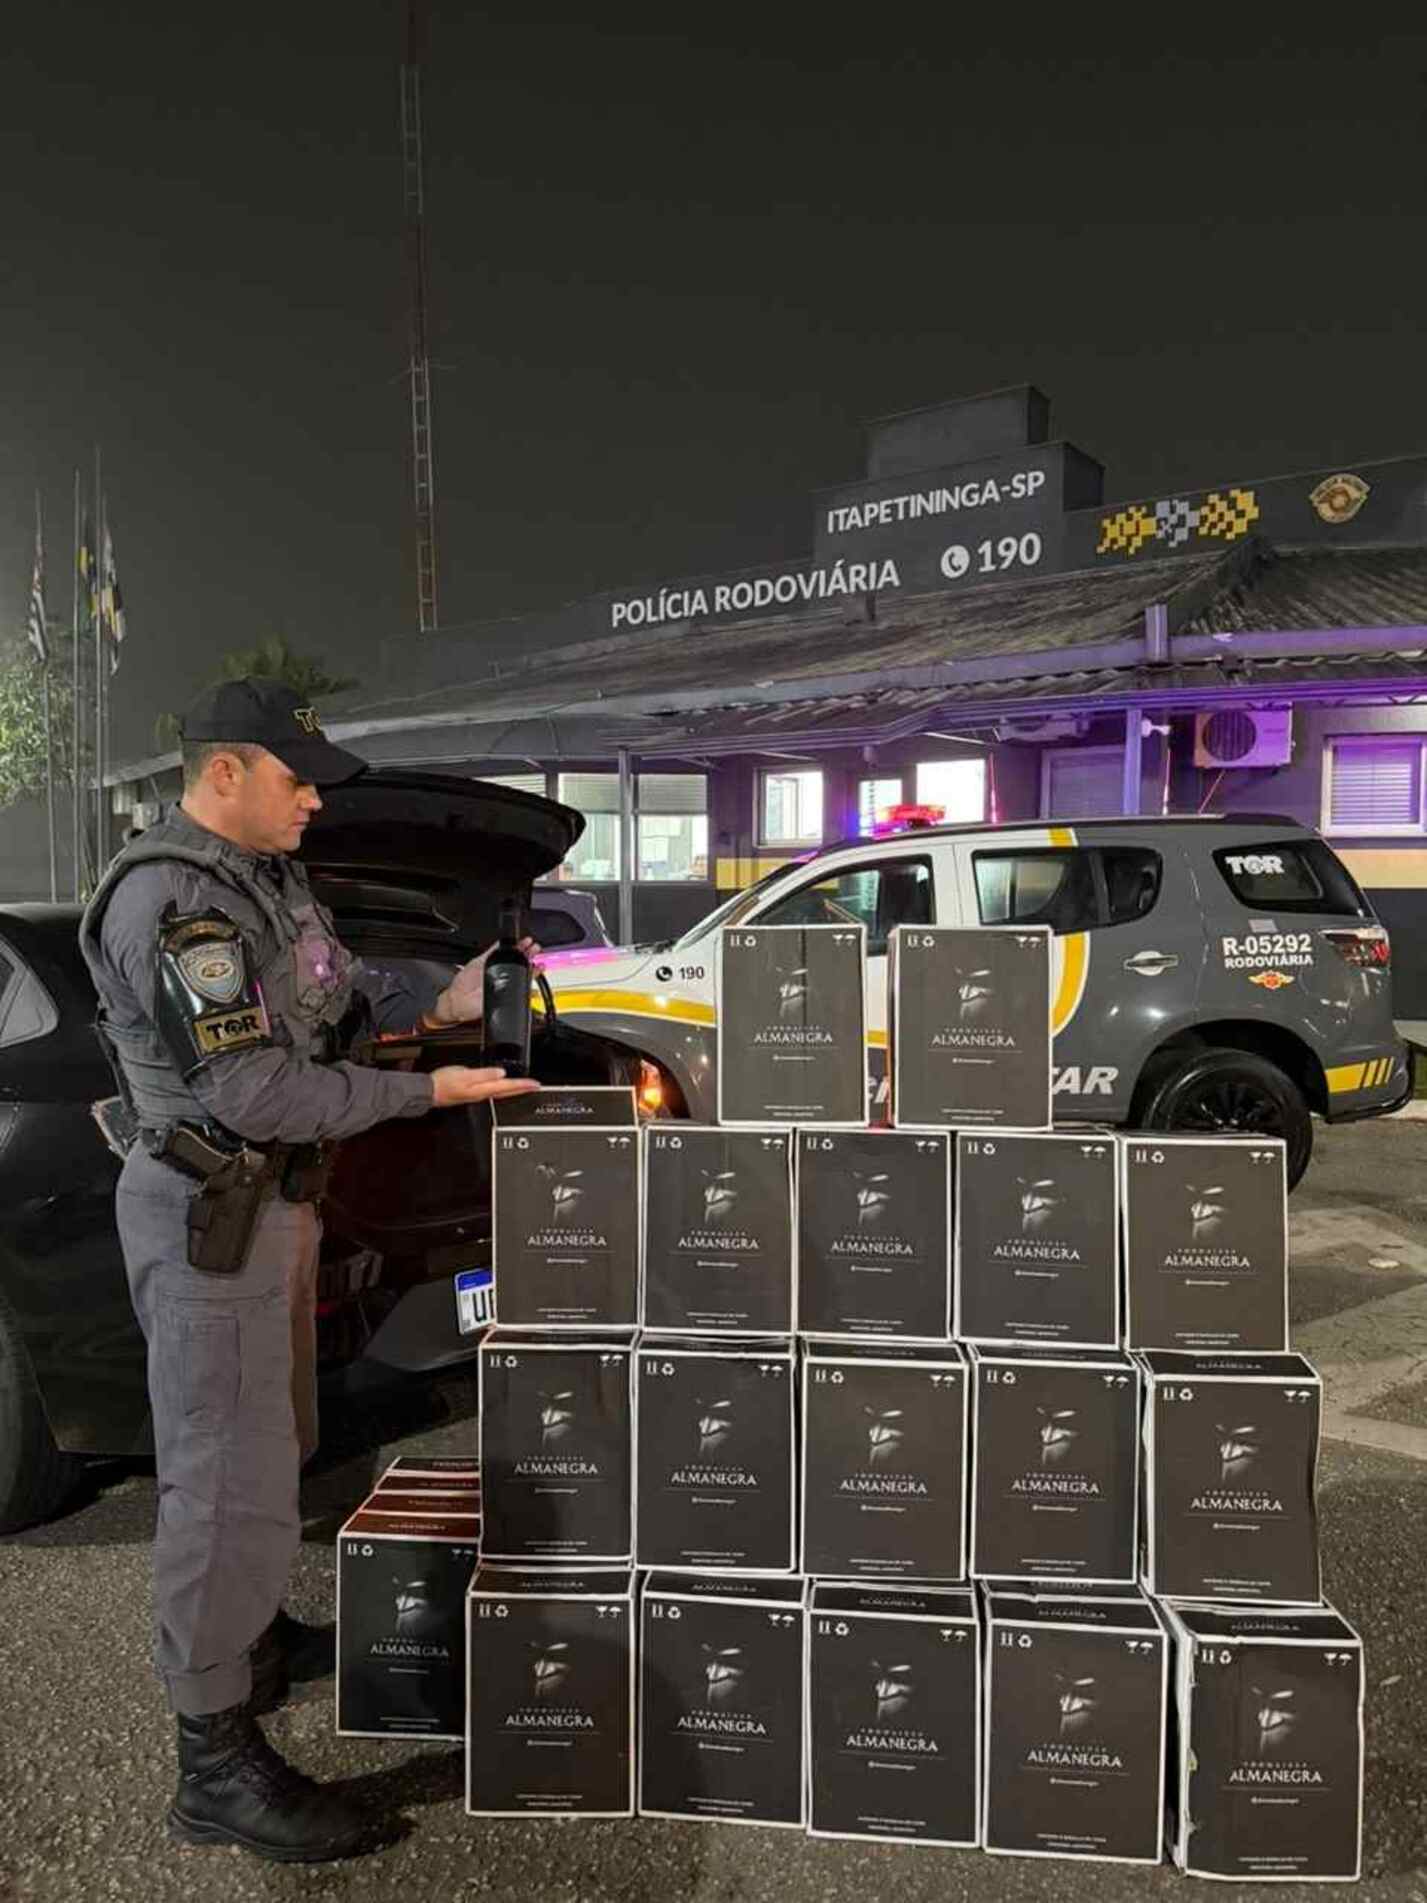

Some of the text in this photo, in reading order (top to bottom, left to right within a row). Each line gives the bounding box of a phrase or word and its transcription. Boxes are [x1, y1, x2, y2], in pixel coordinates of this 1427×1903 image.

[827, 471, 1045, 533] ITAPETININGA-SP
[977, 532, 1042, 573] 190
[612, 559, 900, 628] POLÍCIA RODOVIÁRIA
[1224, 854, 1285, 875] TOR
[1222, 934, 1312, 956] R-05292
[1224, 953, 1313, 969] RODOVIÁRIA
[680, 966, 705, 980] 190
[206, 1015, 260, 1041] TOR
[753, 1032, 833, 1043] ALMANEGRA
[931, 1034, 1015, 1047] ALMANEGRA
[527, 1234, 607, 1247] ALMANEGRA
[678, 1236, 759, 1250] ALMANEGRA
[831, 1241, 913, 1255] ALMANEGRA
[993, 1245, 1081, 1260] ALMANEGRA
[1164, 1255, 1251, 1268] ALMANEGRA
[514, 1462, 599, 1475] ALMANEGRA
[671, 1471, 757, 1486] ALMANEGRA
[839, 1479, 928, 1494] ALMANEGRA
[1011, 1479, 1100, 1494] ALMANEGRA
[1191, 1497, 1283, 1511] ALMANEGRA
[370, 1643, 449, 1657] ALMANEGRA
[505, 1714, 594, 1727] ALMANEGRA
[678, 1716, 766, 1734] ALMANEGRA
[846, 1734, 939, 1752] ALMANEGRA
[1027, 1750, 1122, 1768] ALMANEGRA
[1229, 1768, 1323, 1783] ALMANEGRA
